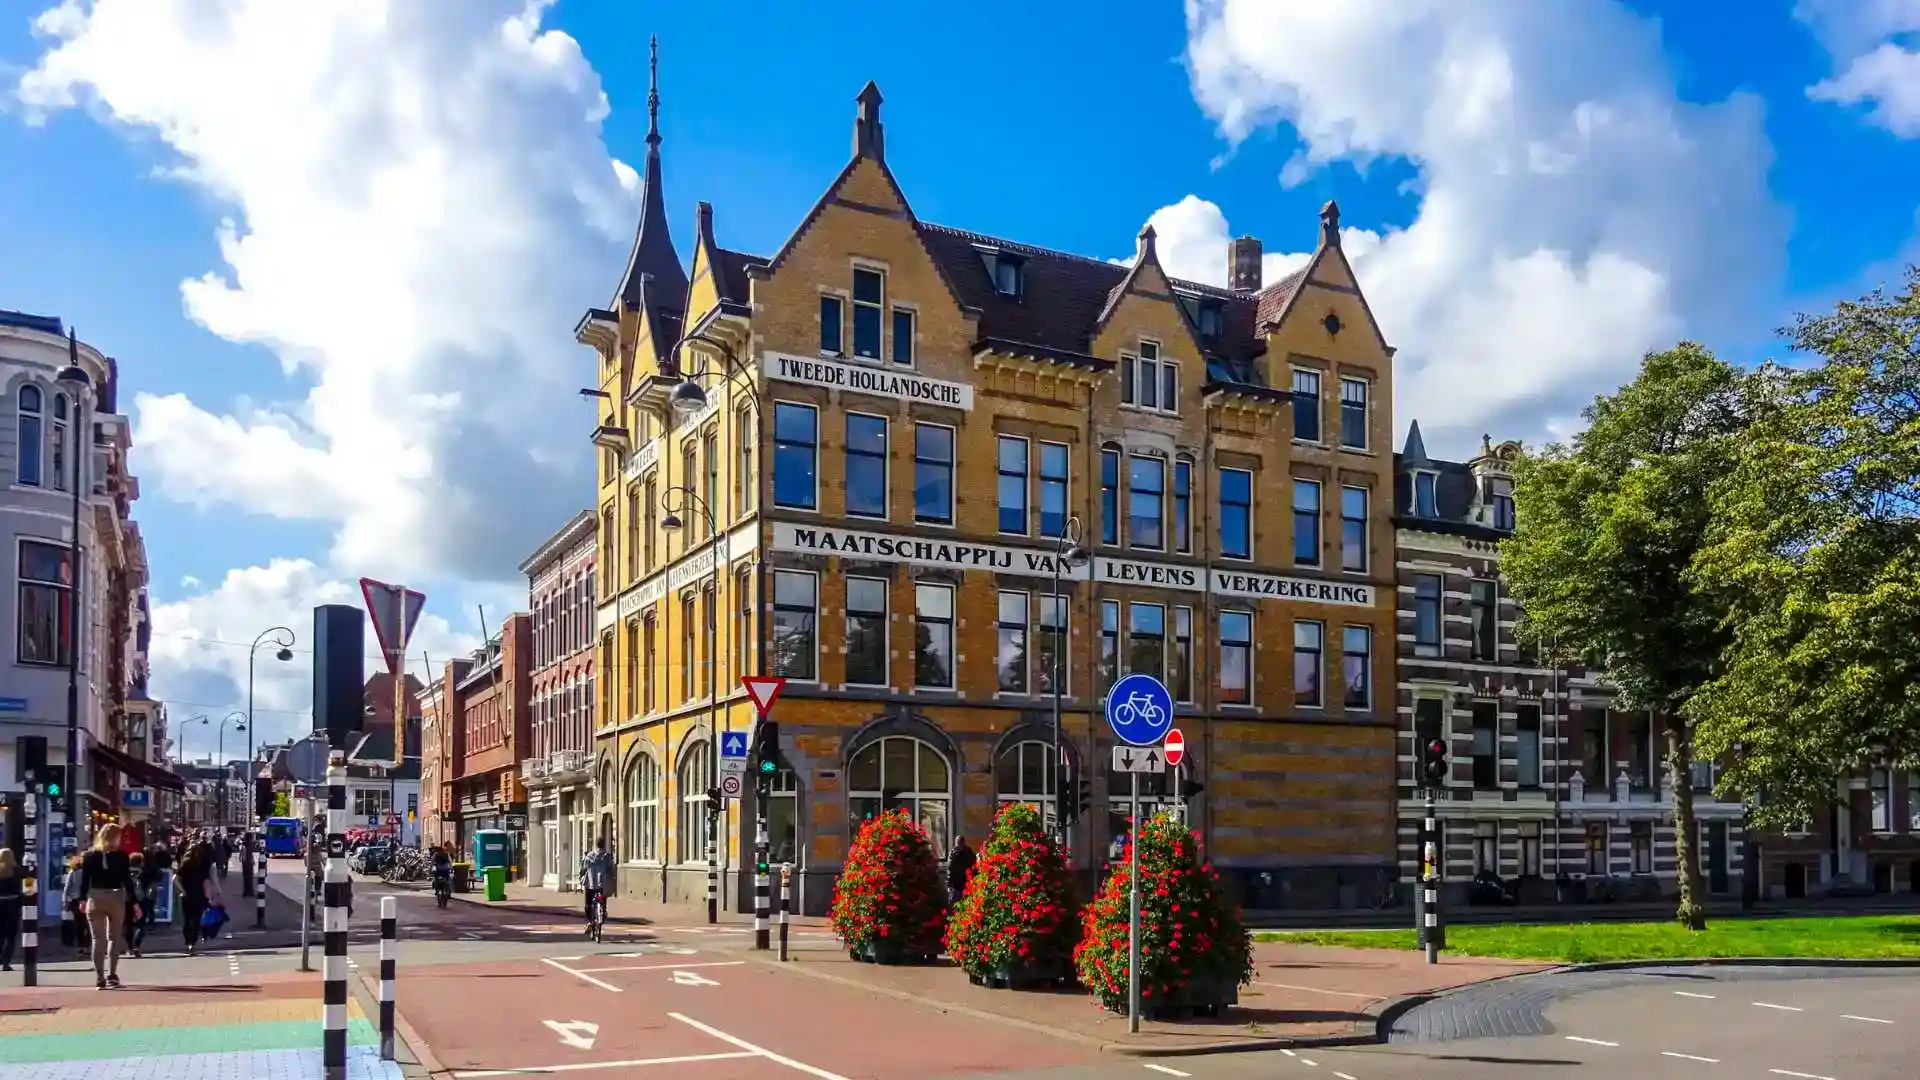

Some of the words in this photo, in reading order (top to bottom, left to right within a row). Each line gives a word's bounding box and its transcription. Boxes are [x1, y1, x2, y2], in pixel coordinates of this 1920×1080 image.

[778, 358, 845, 385] TWEEDE
[849, 370, 961, 403] HOLLANDSCHE
[794, 528, 1012, 567] MAATSCHAPPIJ
[1024, 553, 1072, 574] VAN
[1106, 562, 1195, 586] LEVENS
[1218, 574, 1369, 603] VERZEKERING
